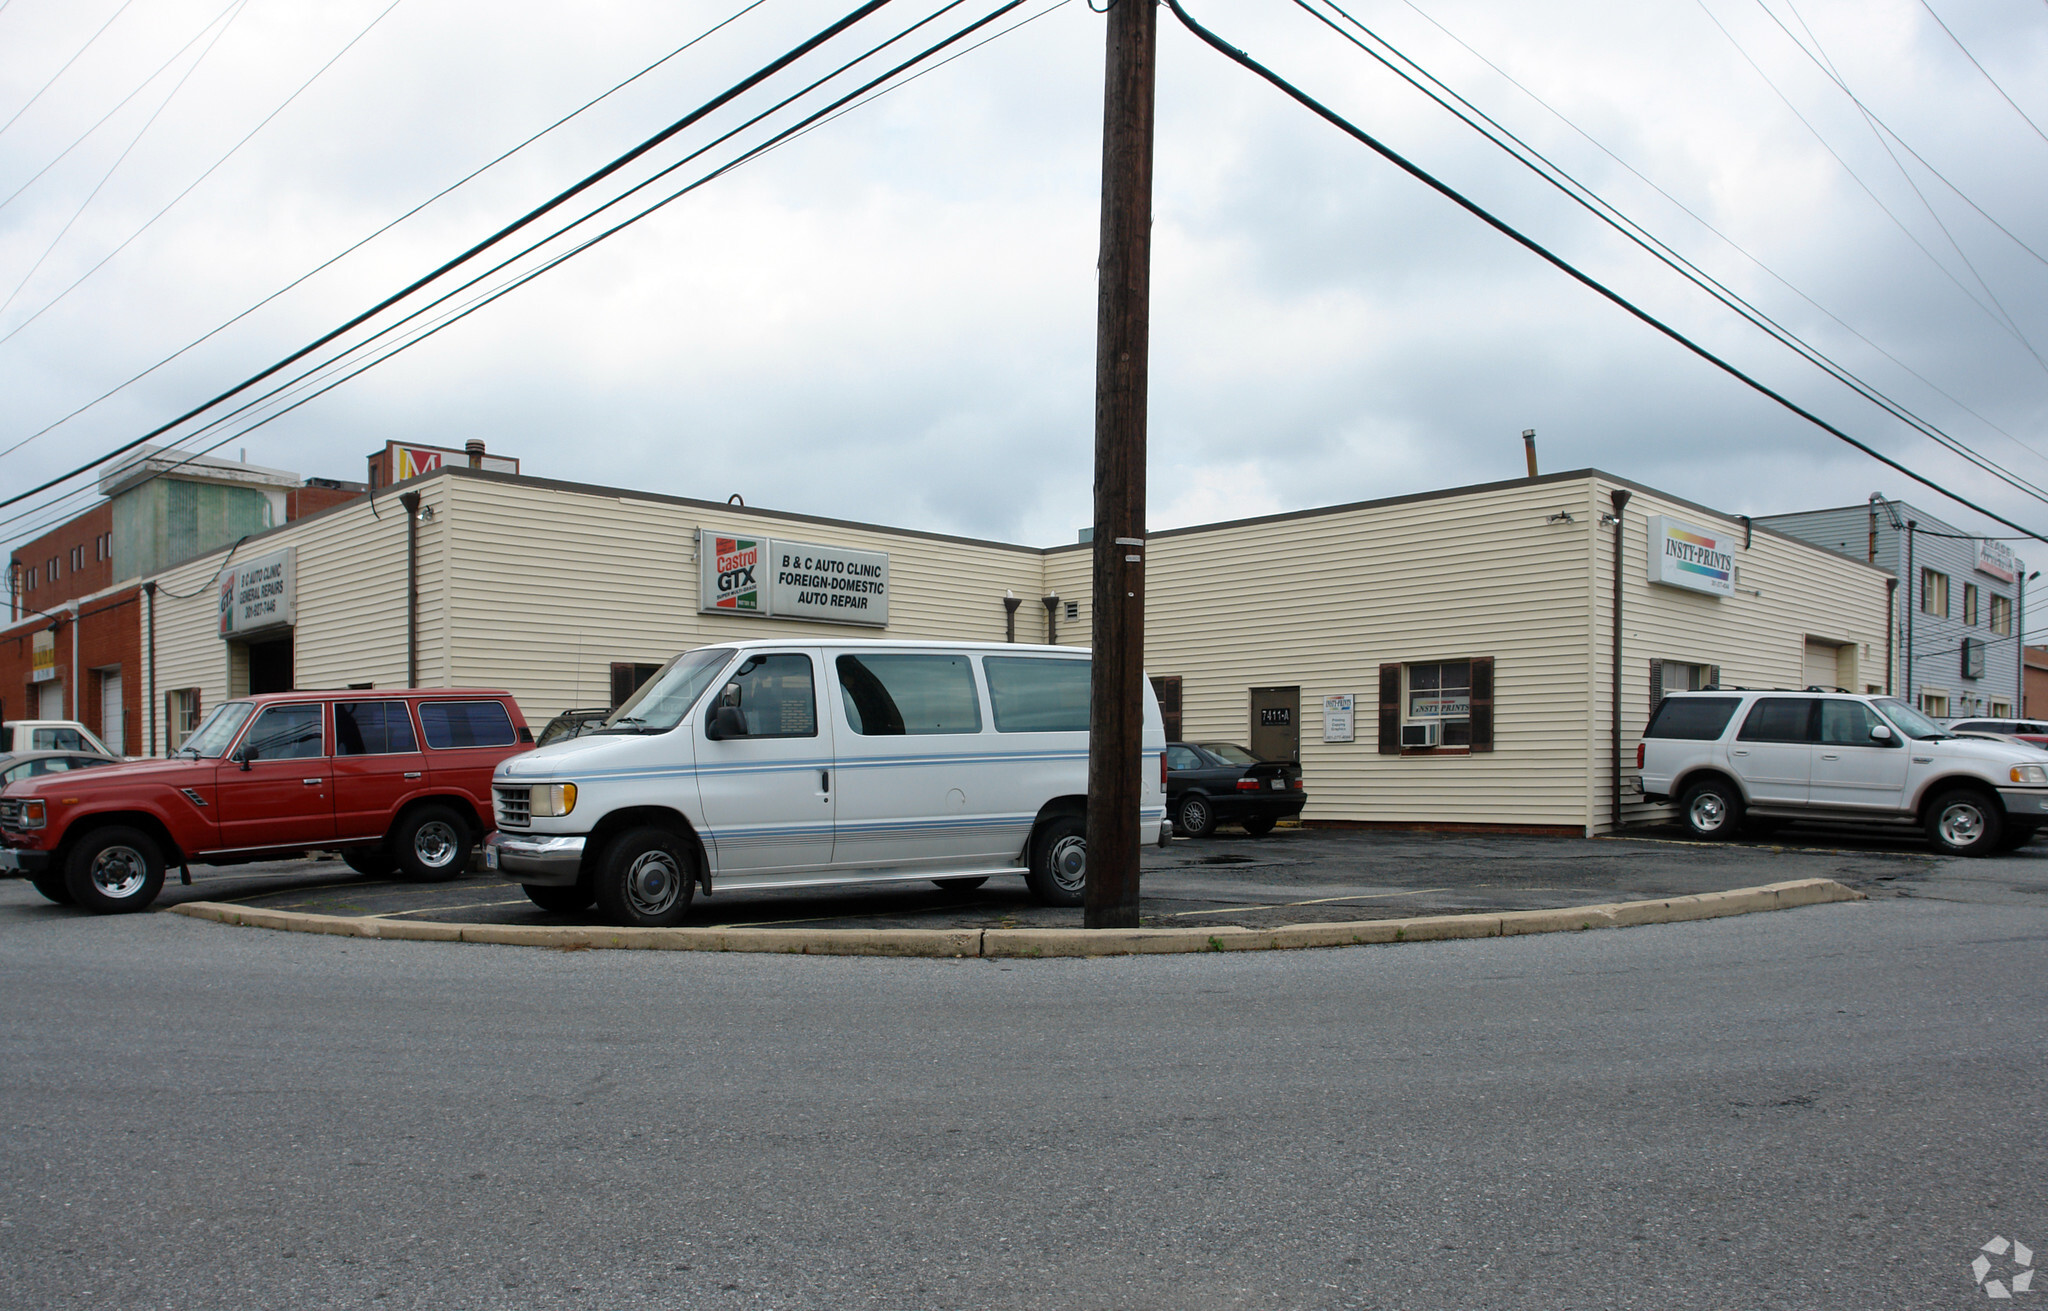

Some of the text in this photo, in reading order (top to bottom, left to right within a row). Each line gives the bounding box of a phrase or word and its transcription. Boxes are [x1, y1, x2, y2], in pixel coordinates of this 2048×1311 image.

[716, 547, 757, 573] Castrol
[782, 555, 882, 578] B & C AUTO CLINIC
[249, 568, 262, 584] AUTO
[263, 562, 282, 580] CLINIC
[717, 565, 756, 591] GTX
[221, 584, 234, 612] GTX
[240, 579, 283, 604] GENERAL REPAIRS
[798, 591, 868, 609] AUTO REPAIR
